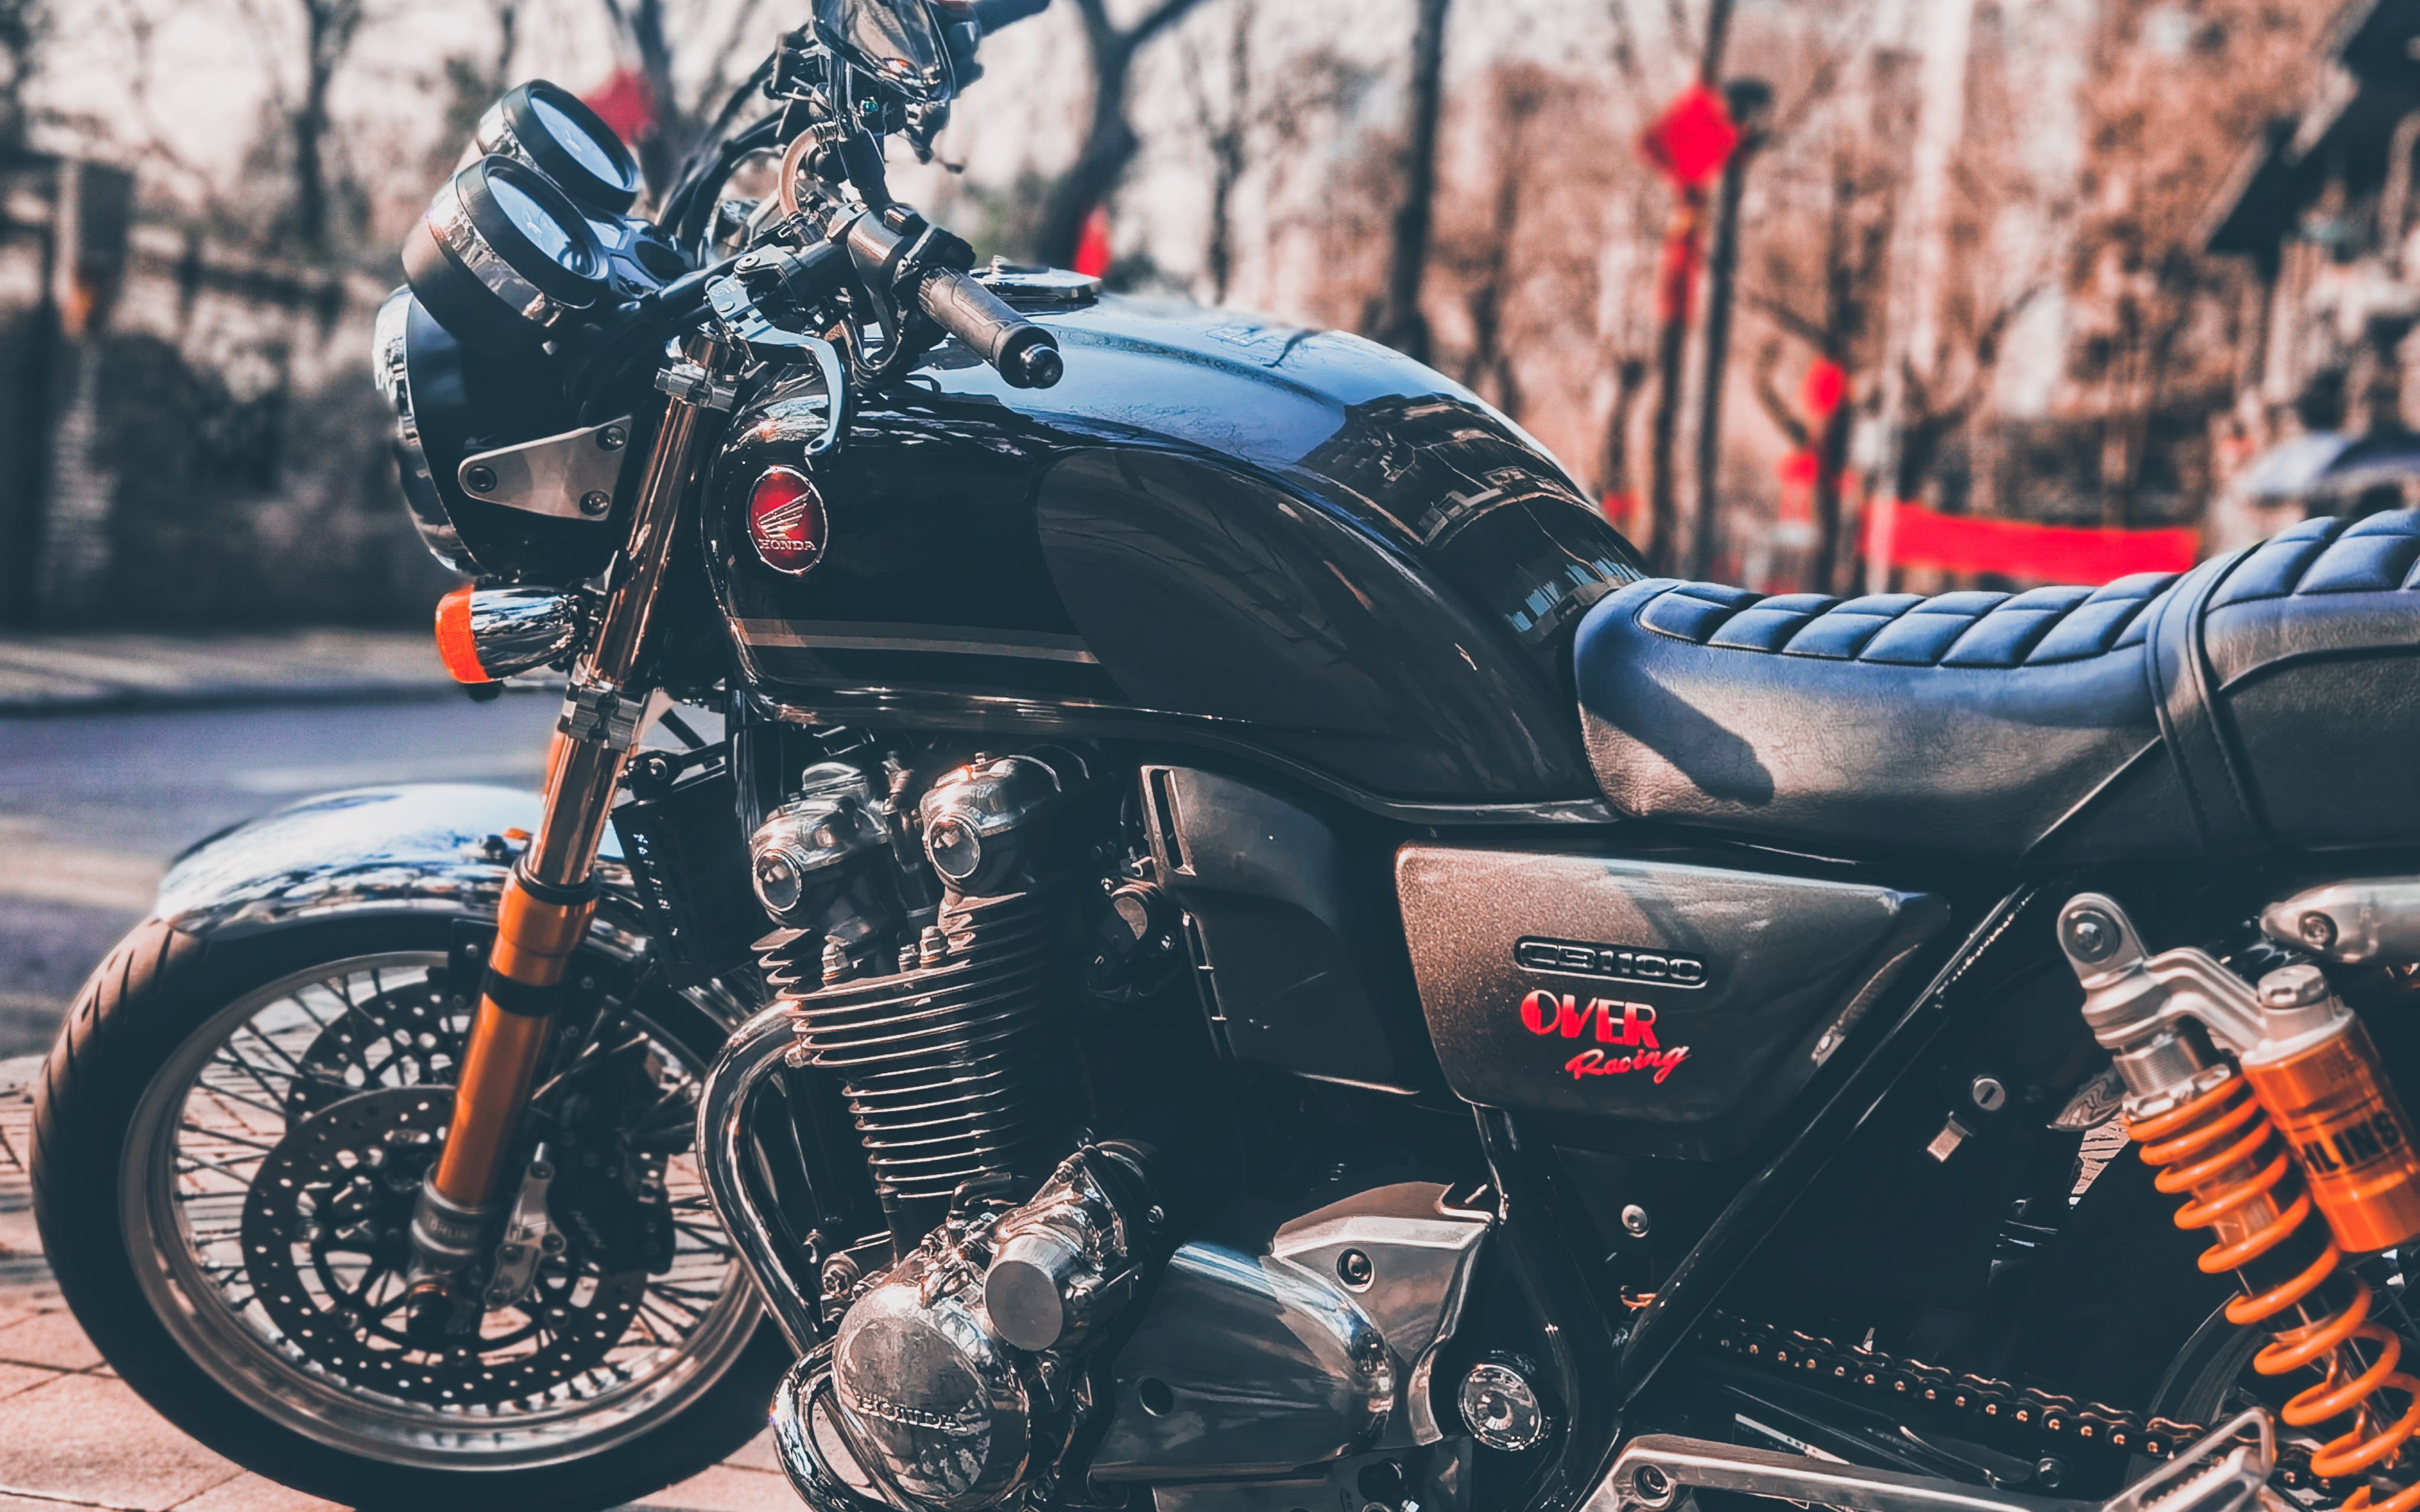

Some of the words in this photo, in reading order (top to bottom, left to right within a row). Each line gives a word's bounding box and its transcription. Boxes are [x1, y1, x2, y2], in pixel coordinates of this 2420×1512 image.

[758, 538, 817, 550] HONDA
[1520, 942, 1702, 981] CB1100
[1520, 989, 1660, 1049] OVER
[1564, 1046, 1692, 1084] Racing
[857, 1394, 968, 1432] HONDA
